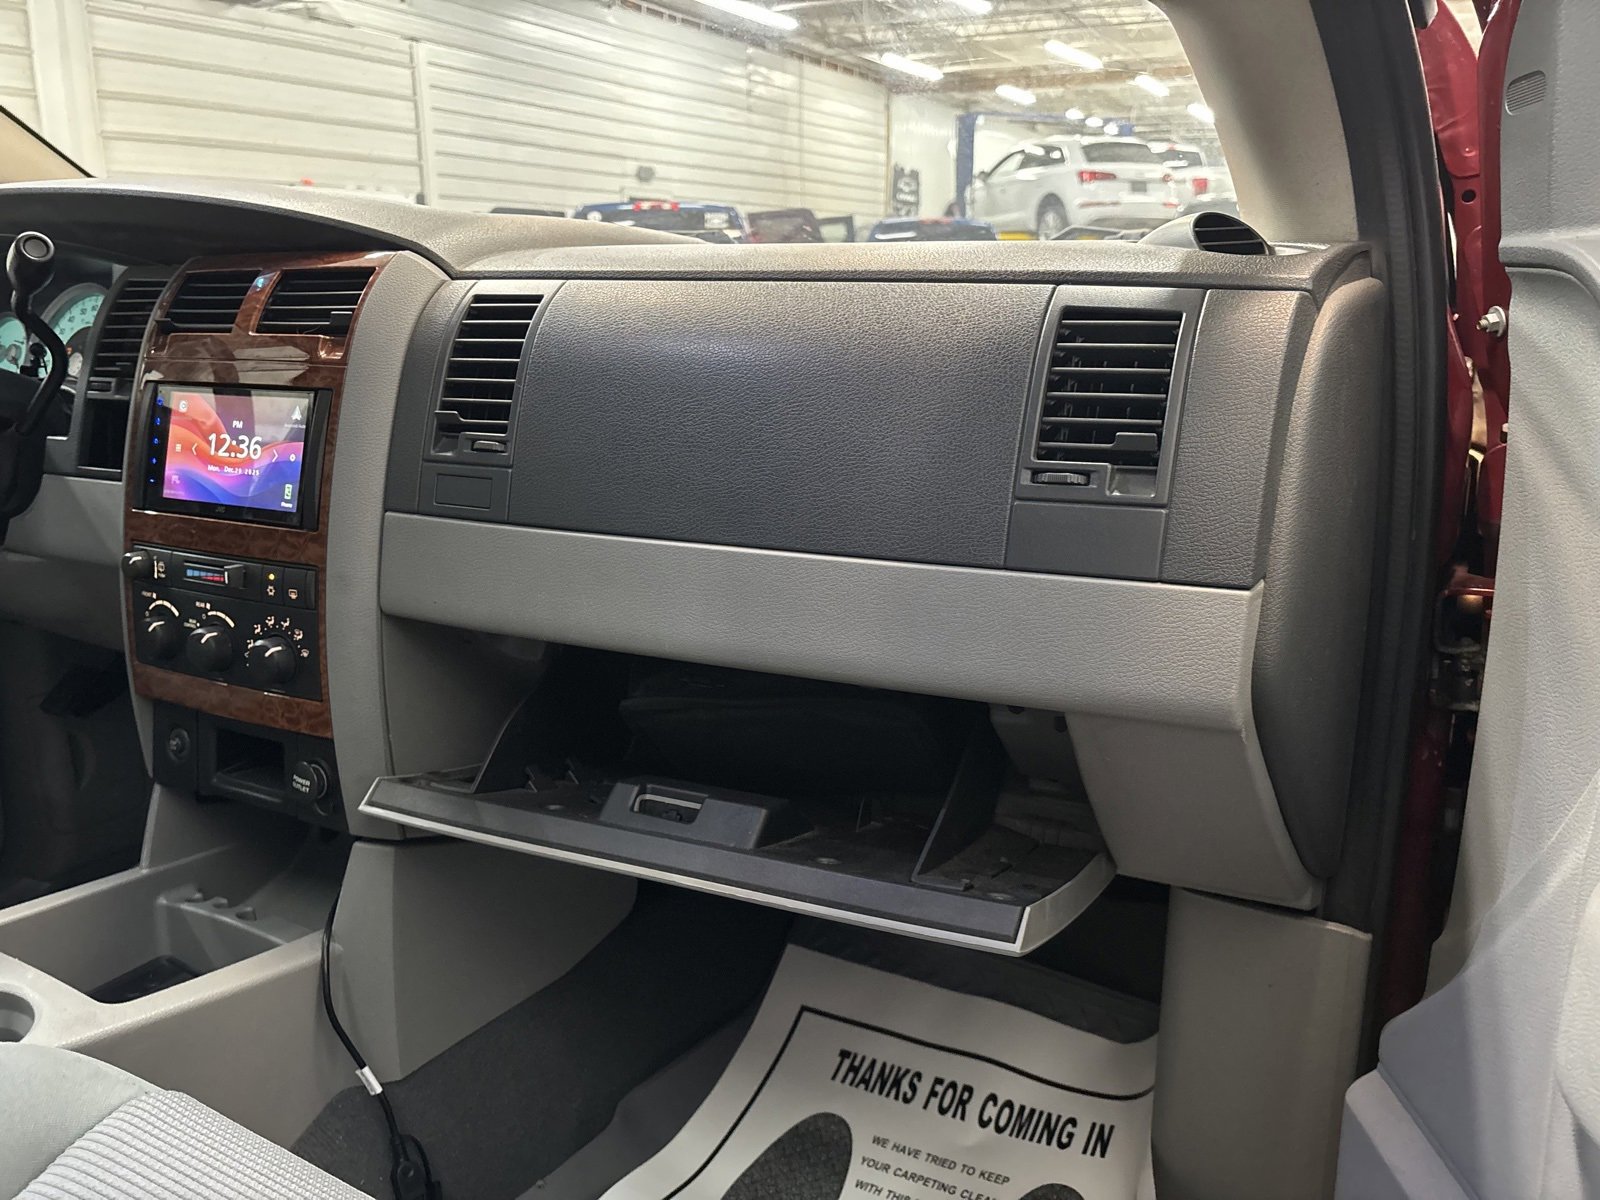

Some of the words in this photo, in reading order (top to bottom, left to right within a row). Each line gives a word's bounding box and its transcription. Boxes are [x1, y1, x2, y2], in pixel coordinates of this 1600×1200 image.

[232, 420, 243, 429] PM
[208, 432, 263, 460] 12:36
[292, 774, 311, 786] POWER
[831, 1048, 922, 1104] THANKS
[922, 1076, 974, 1121] FOR
[978, 1092, 1078, 1150] COMING
[1081, 1121, 1115, 1158] IN
[871, 1135, 890, 1149] WE
[891, 1140, 922, 1160] HAVE
[924, 1152, 957, 1171] TRIED
[960, 1163, 976, 1176] TO
[978, 1169, 1010, 1186] KEEP
[855, 1179, 883, 1196] WITH
[860, 1156, 891, 1174] YOUR
[893, 1167, 957, 1195] CARPETING
